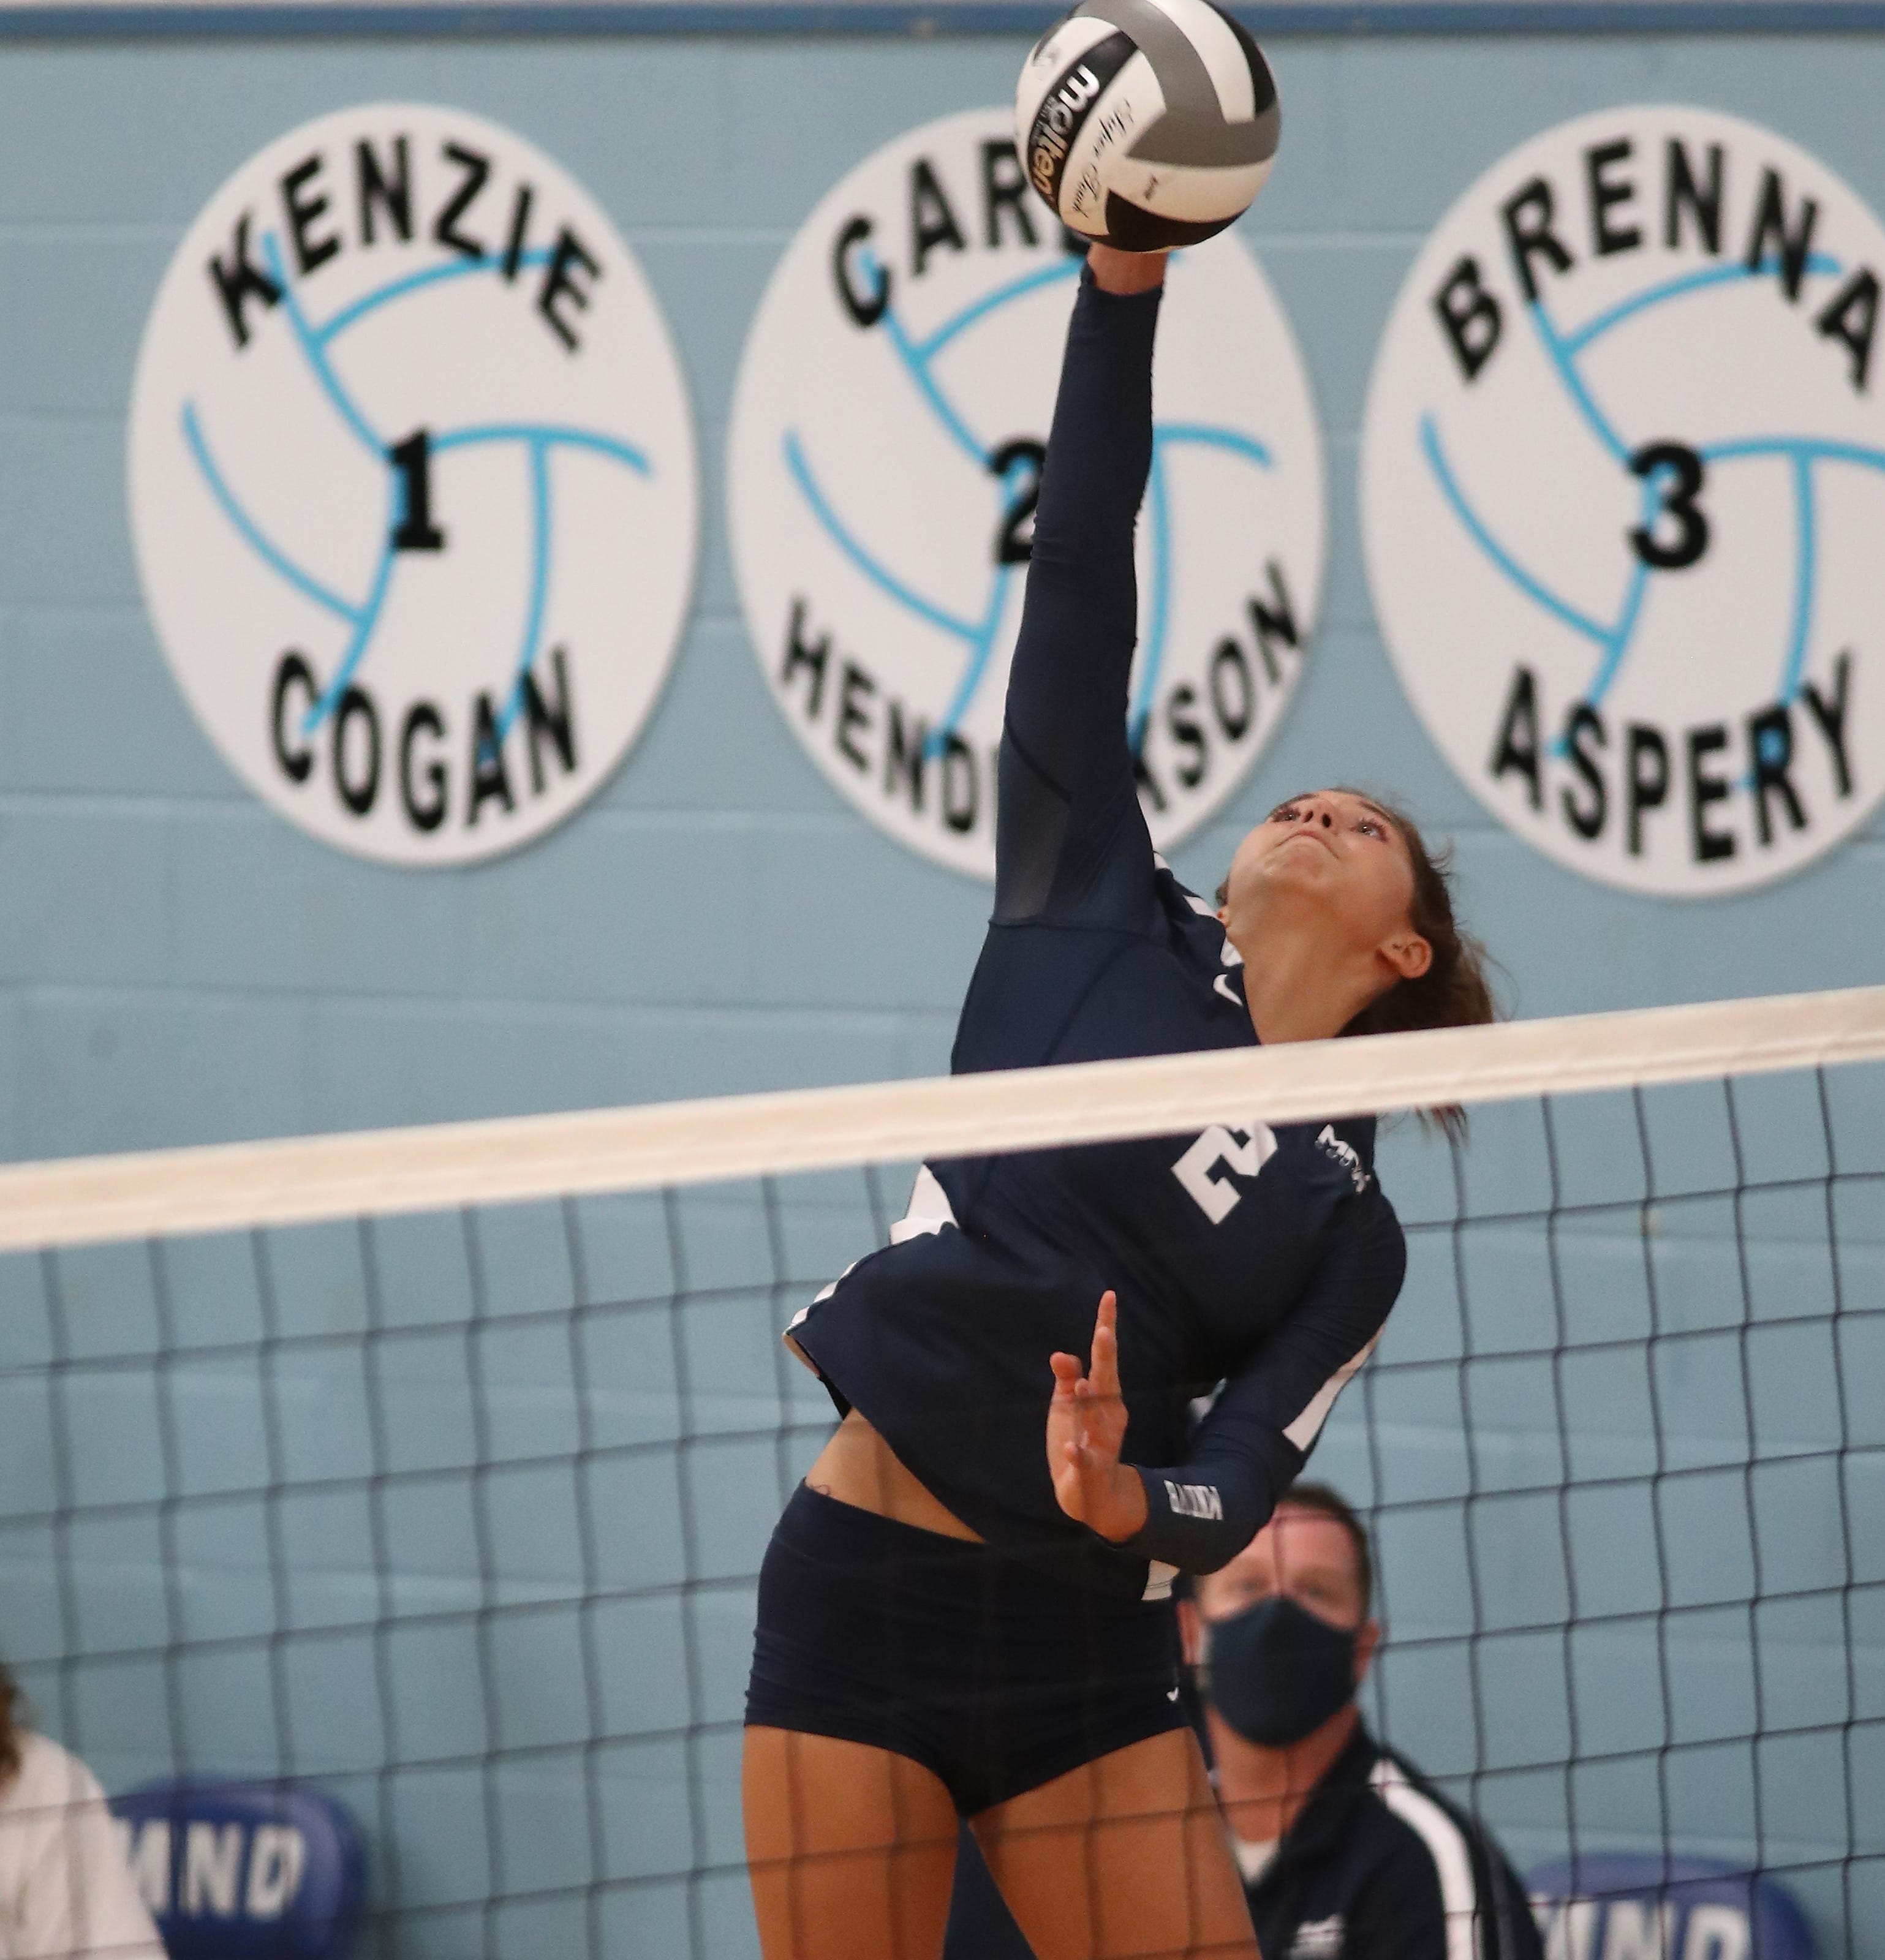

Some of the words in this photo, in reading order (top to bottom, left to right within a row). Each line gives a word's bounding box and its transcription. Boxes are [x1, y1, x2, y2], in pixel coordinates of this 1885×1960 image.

[208, 135, 603, 353] KENZIE
[832, 138, 1097, 330] CAR
[1430, 135, 1885, 398] BRENNA
[388, 425, 446, 554] 1
[988, 436, 1045, 565] 2
[1626, 439, 1709, 570] 3
[268, 641, 580, 834] COGAN
[1487, 646, 1854, 864] ASPERY
[1170, 1126, 1279, 1225] 2
